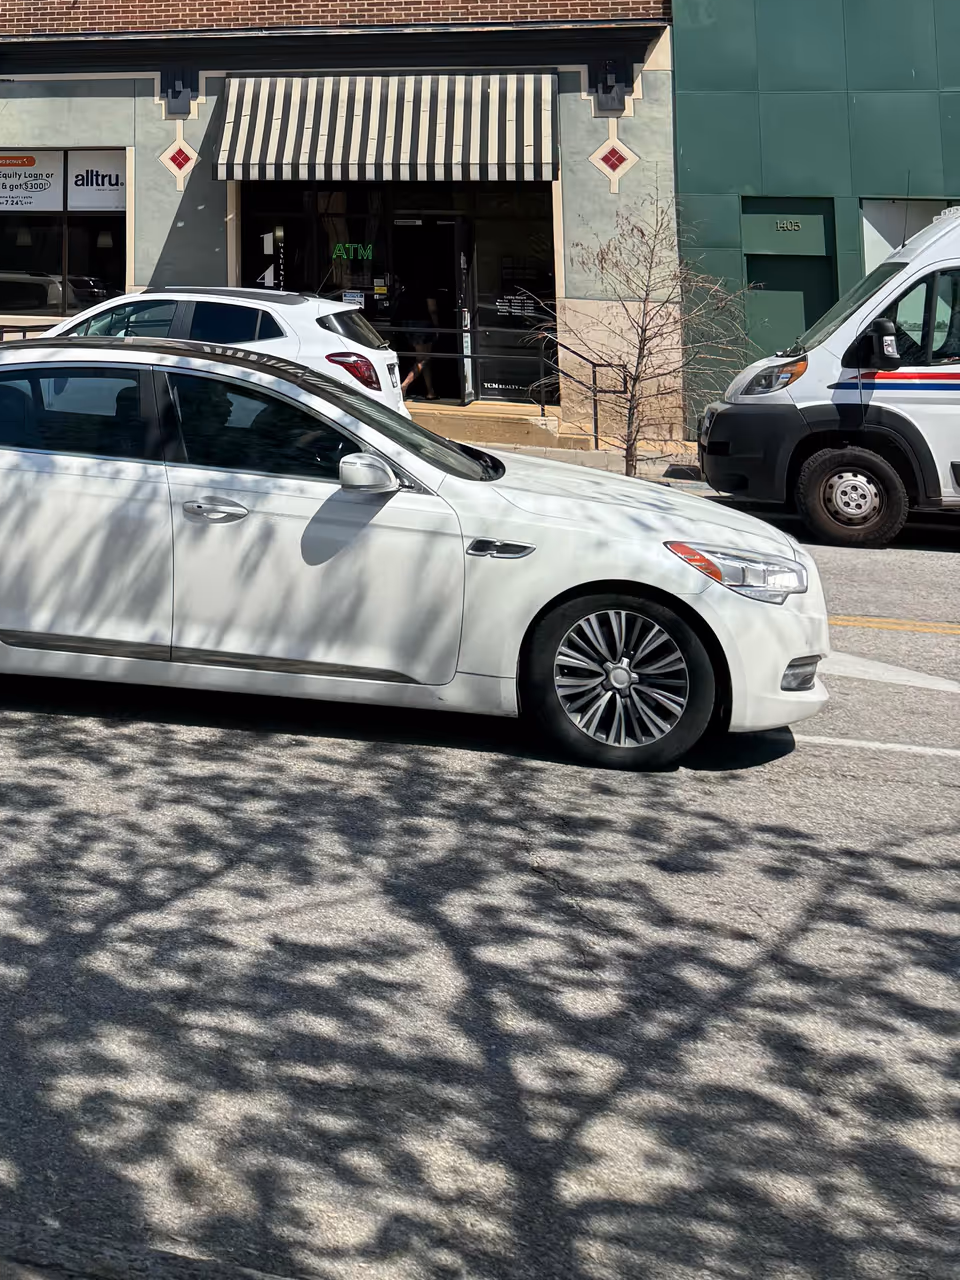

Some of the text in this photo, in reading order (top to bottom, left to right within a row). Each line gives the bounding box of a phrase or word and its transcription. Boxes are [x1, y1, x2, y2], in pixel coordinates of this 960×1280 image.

[24, 171, 43, 179] Loan
[9, 183, 23, 191] get
[775, 220, 802, 232] 1405
[332, 243, 373, 260] ATM
